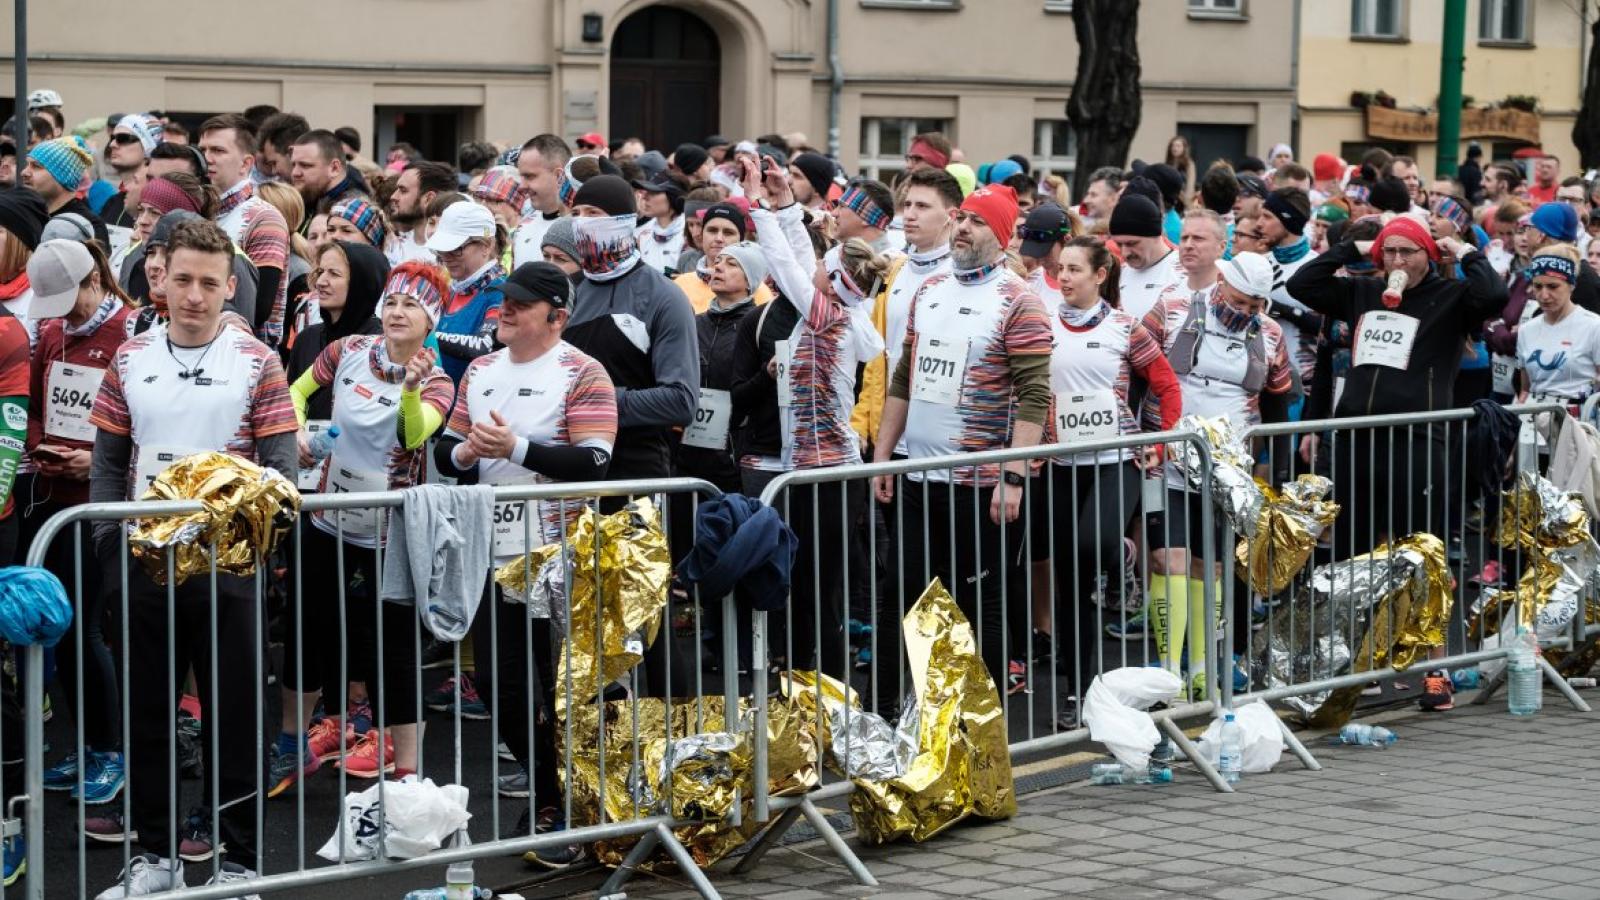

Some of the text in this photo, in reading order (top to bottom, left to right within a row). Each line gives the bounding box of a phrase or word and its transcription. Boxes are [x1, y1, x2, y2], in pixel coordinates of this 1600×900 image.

[1364, 328, 1404, 345] 9402
[918, 356, 956, 378] 10711
[51, 386, 92, 411] 5494
[695, 408, 715, 424] 07
[1059, 409, 1114, 430] 10403
[493, 502, 525, 524] 567
